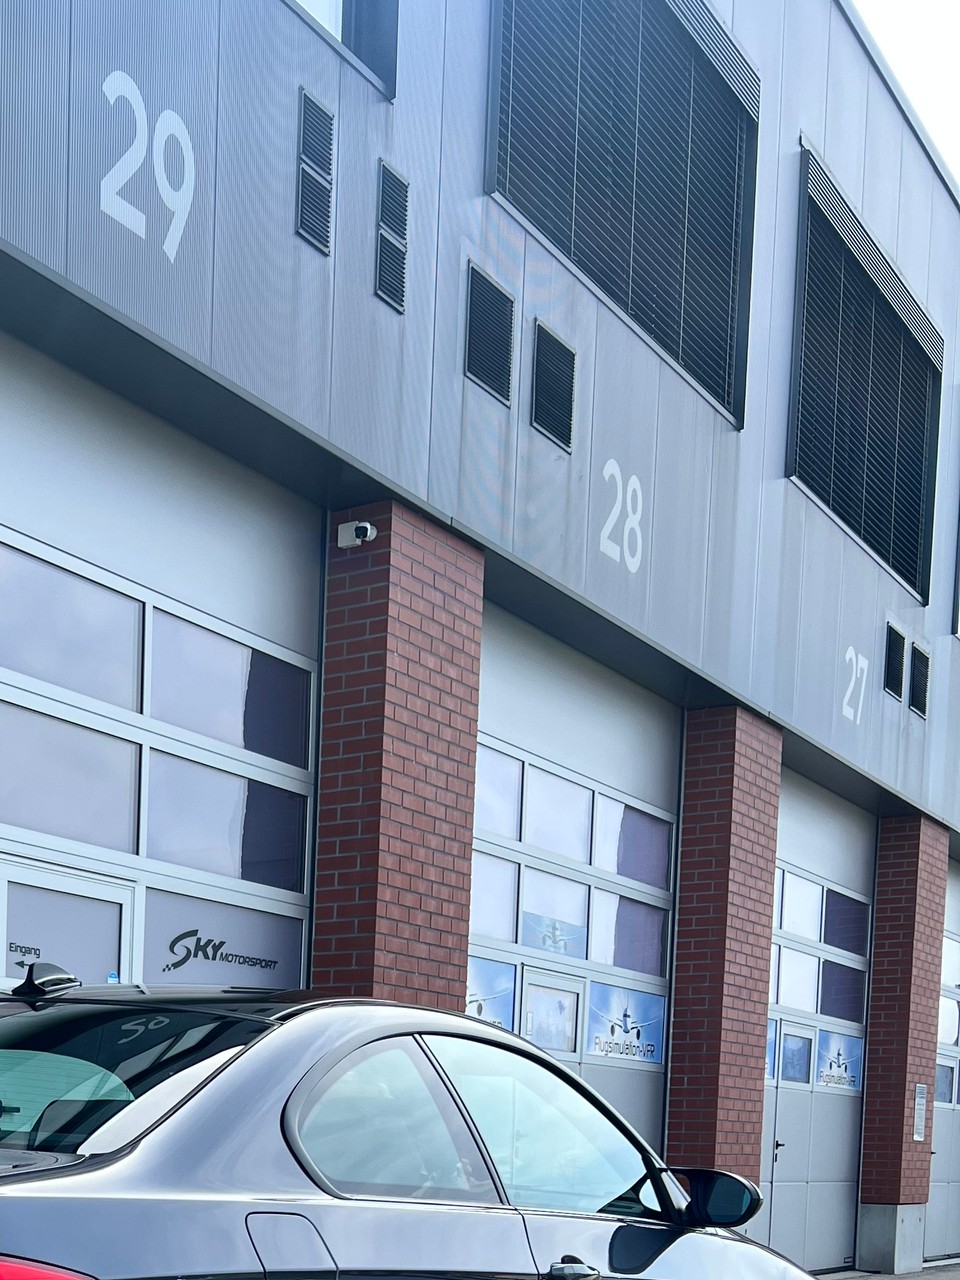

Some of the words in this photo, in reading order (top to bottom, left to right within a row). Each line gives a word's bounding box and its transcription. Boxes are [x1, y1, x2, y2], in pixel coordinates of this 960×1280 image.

[100, 70, 195, 264] 29
[600, 458, 643, 573] 28
[842, 646, 869, 725] 27
[9, 942, 41, 958] Eingang
[166, 929, 226, 971] SKY
[219, 952, 278, 971] MOTORSPORT
